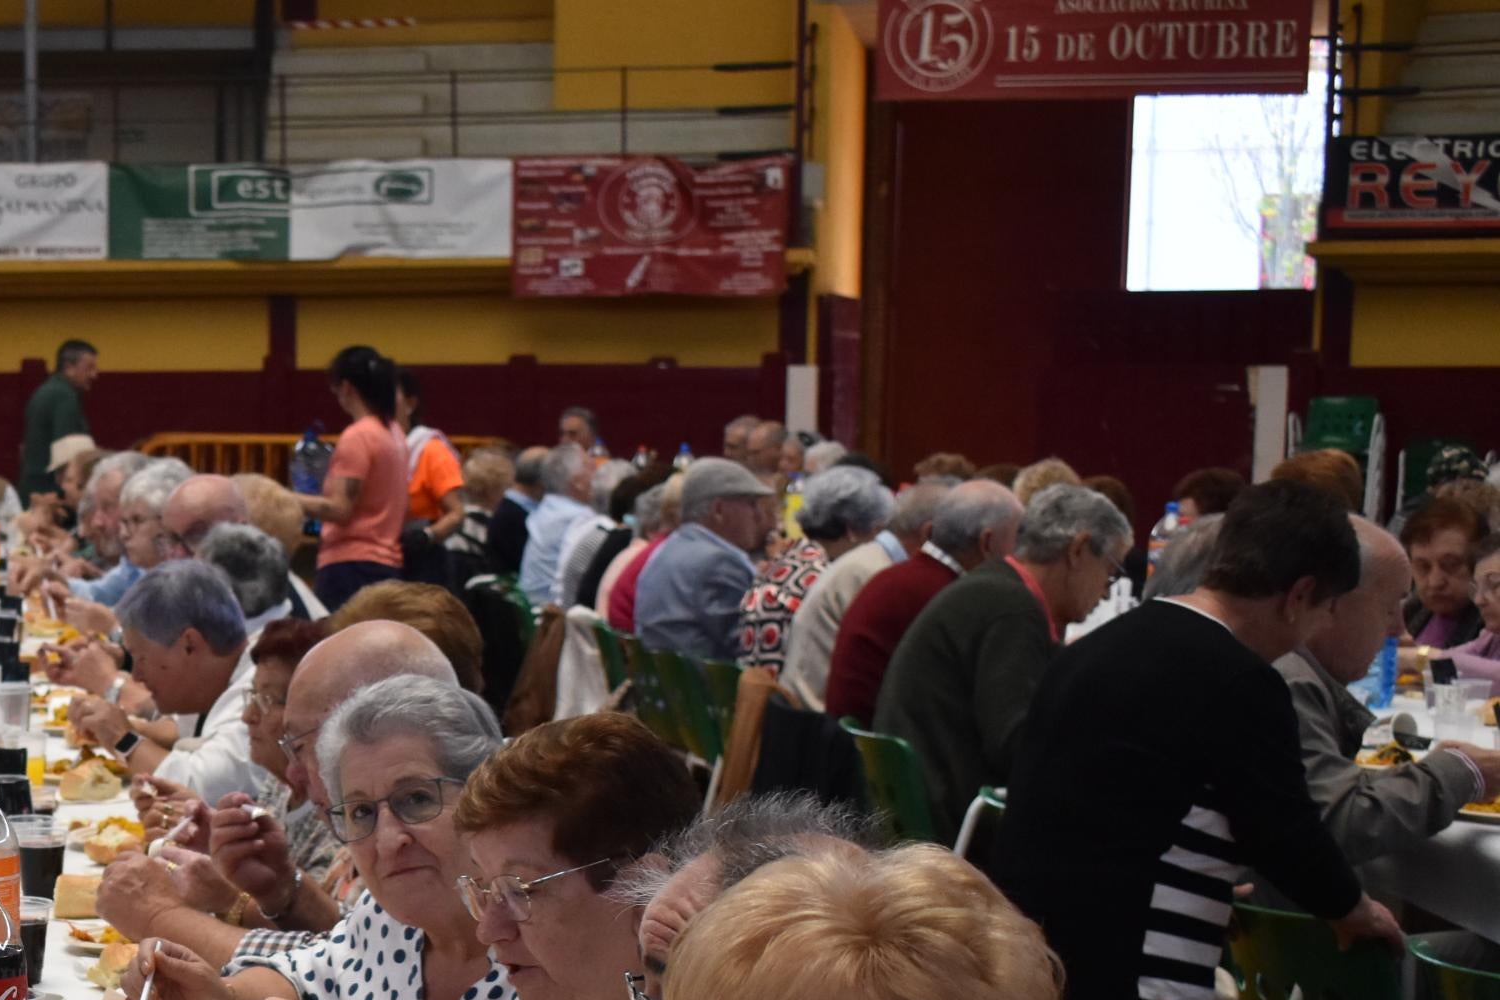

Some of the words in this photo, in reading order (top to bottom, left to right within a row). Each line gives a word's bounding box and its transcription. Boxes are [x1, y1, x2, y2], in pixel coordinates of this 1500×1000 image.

[915, 10, 971, 70] 15
[1004, 25, 1041, 63] 15
[1055, 33, 1096, 62] DE
[1108, 19, 1300, 62] OCTUBRE
[15, 172, 77, 188] GRUPO
[1346, 160, 1500, 211] REY
